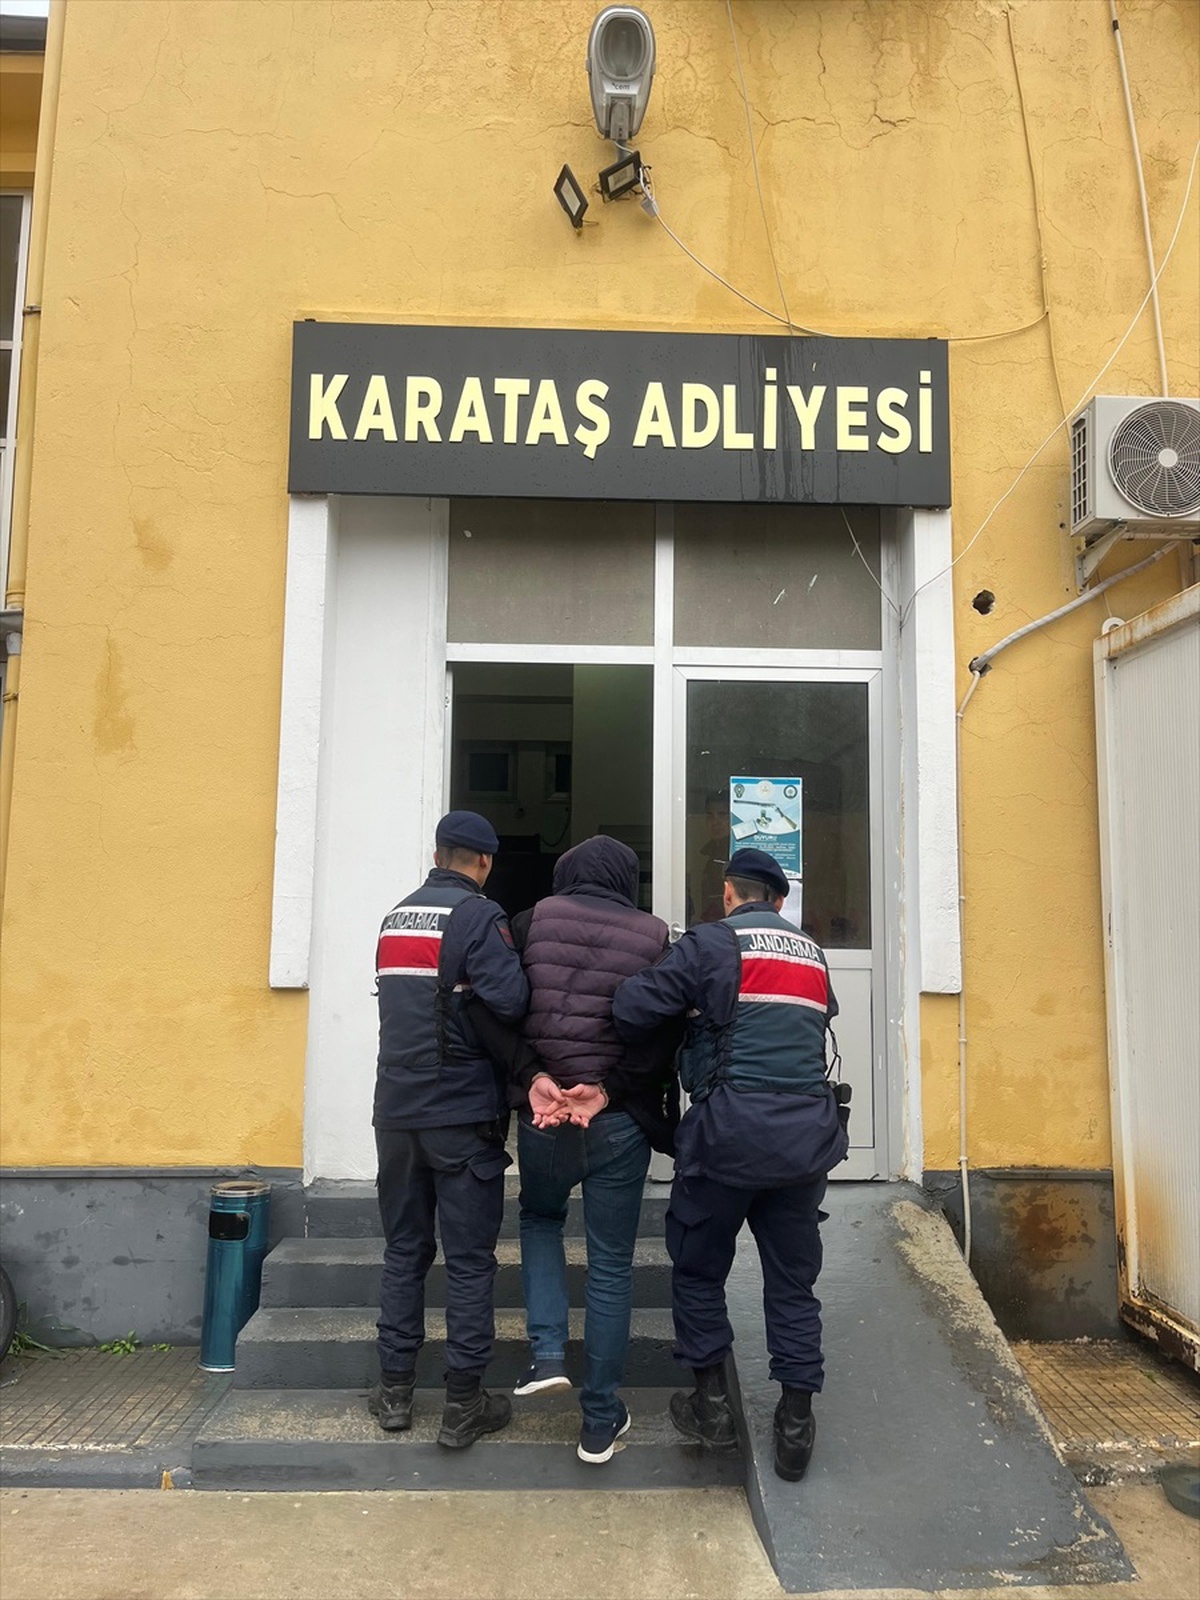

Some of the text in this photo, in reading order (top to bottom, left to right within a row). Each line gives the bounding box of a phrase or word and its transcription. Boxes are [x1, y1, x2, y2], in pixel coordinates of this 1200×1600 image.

[308, 367, 933, 459] KARATAŞ ADLİYESİ
[383, 912, 440, 930] ANDARMA
[749, 934, 820, 961] JANDARMA
